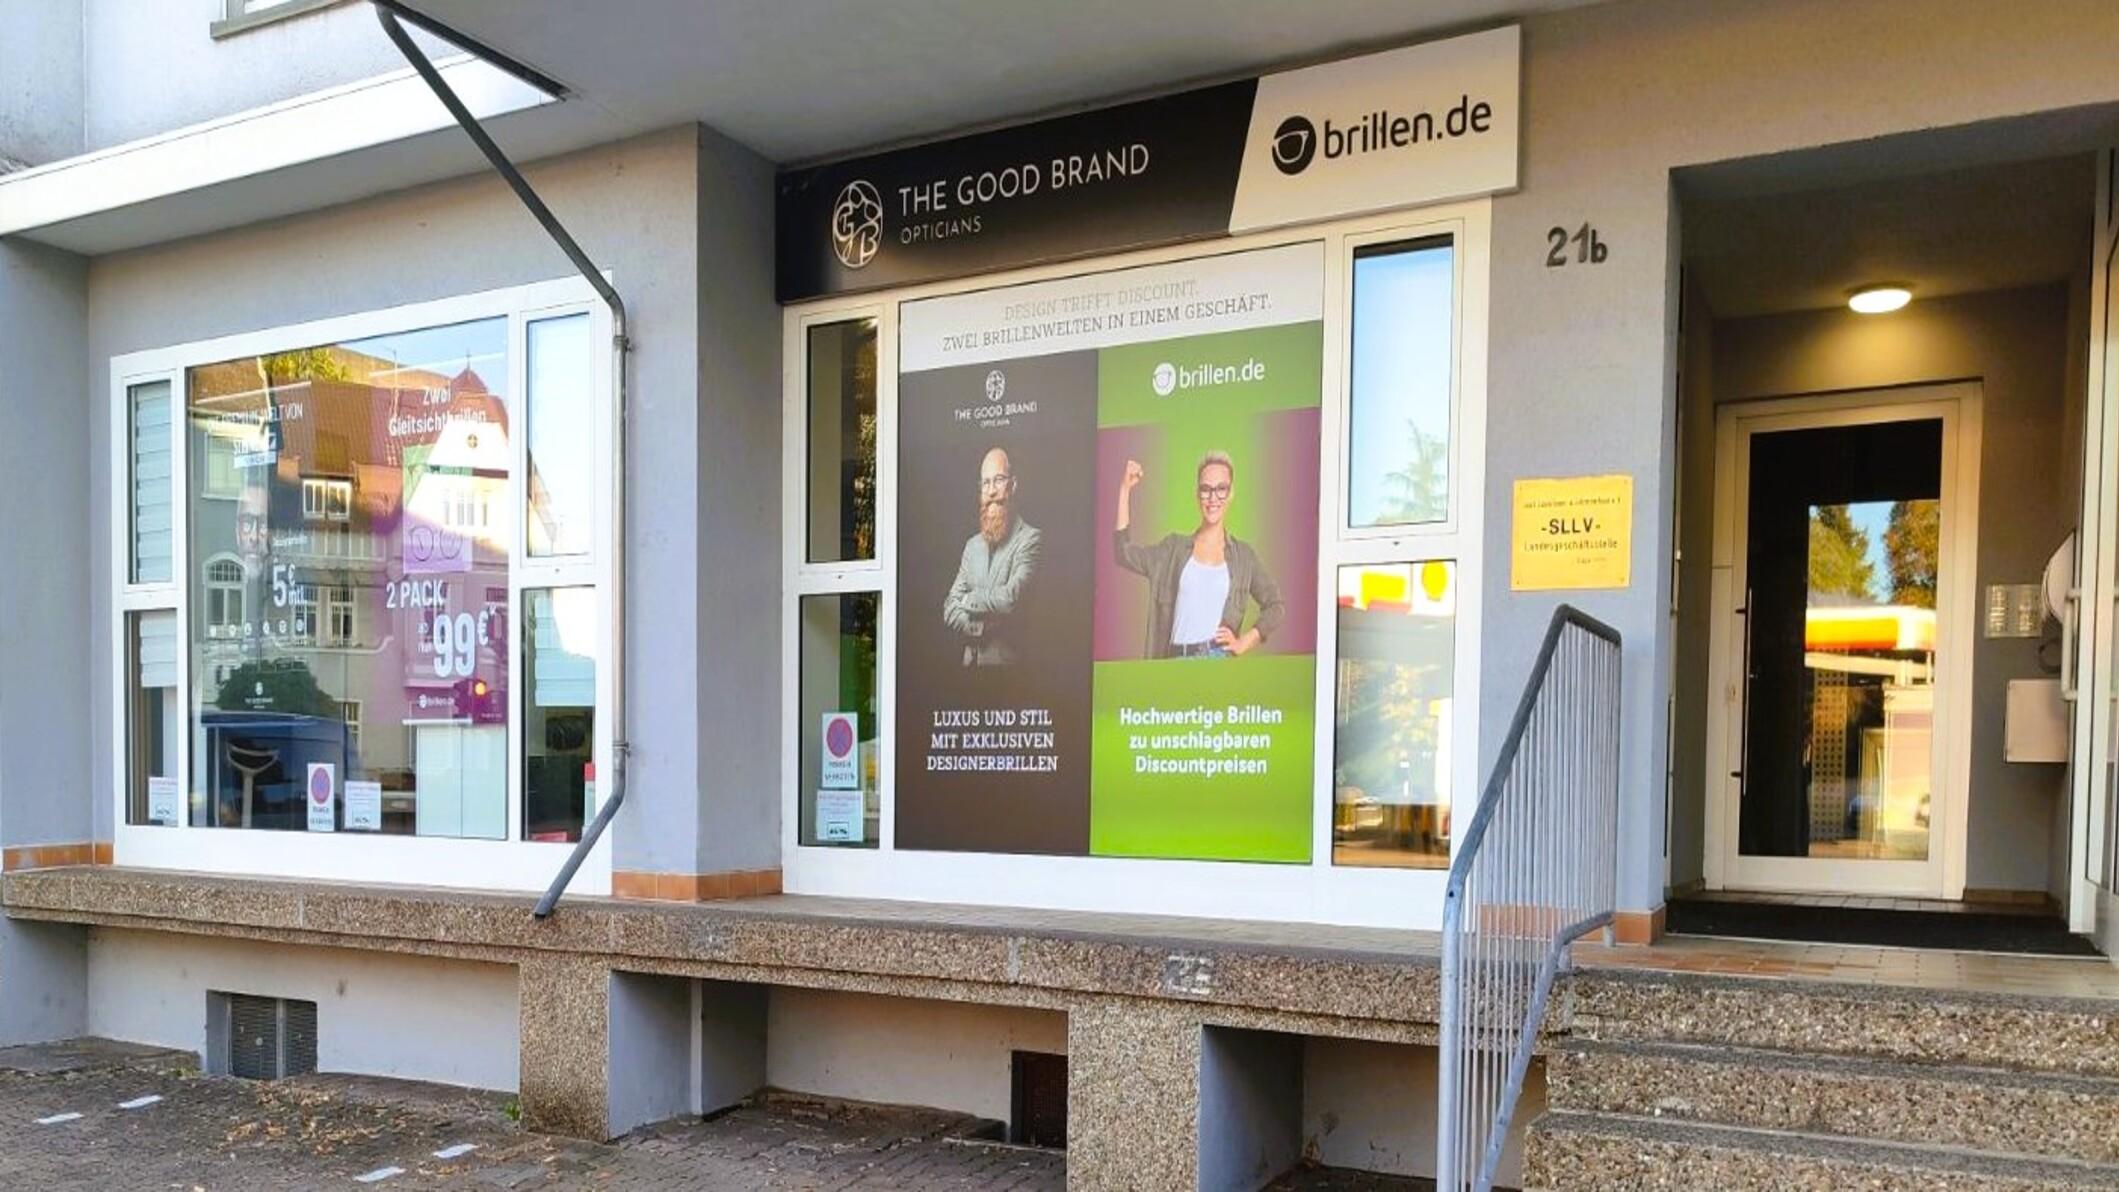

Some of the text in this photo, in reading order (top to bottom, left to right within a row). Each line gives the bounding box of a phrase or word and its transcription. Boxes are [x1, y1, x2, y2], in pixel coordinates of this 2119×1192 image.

[1324, 94, 1492, 159] brillen.de
[899, 143, 1150, 217] THE GOOD BRAND
[901, 215, 983, 244] OPTICIANS
[1546, 221, 1608, 267] 21b
[1004, 279, 1200, 321] DESIGN TRIFFT DISCOUNT.
[942, 293, 1273, 352] ZWEI BRILLENWELTEN IN EINEM GESCHÄFT.
[1179, 358, 1265, 389] brillen.de
[286, 402, 303, 420] VON
[954, 401, 1038, 420] THE GOOD BRAND
[385, 579, 444, 609] 2 PACK
[933, 709, 1052, 726] LUXUS UND STIL
[1120, 706, 1282, 729] Hochwertige Brillen
[931, 732, 1055, 749] MIT EXKLUSIVEN
[1129, 731, 1271, 755] zu unschlagbaren
[927, 755, 1059, 772] DESIGNERBRILLEN
[1135, 755, 1267, 779] Discountpreisen
